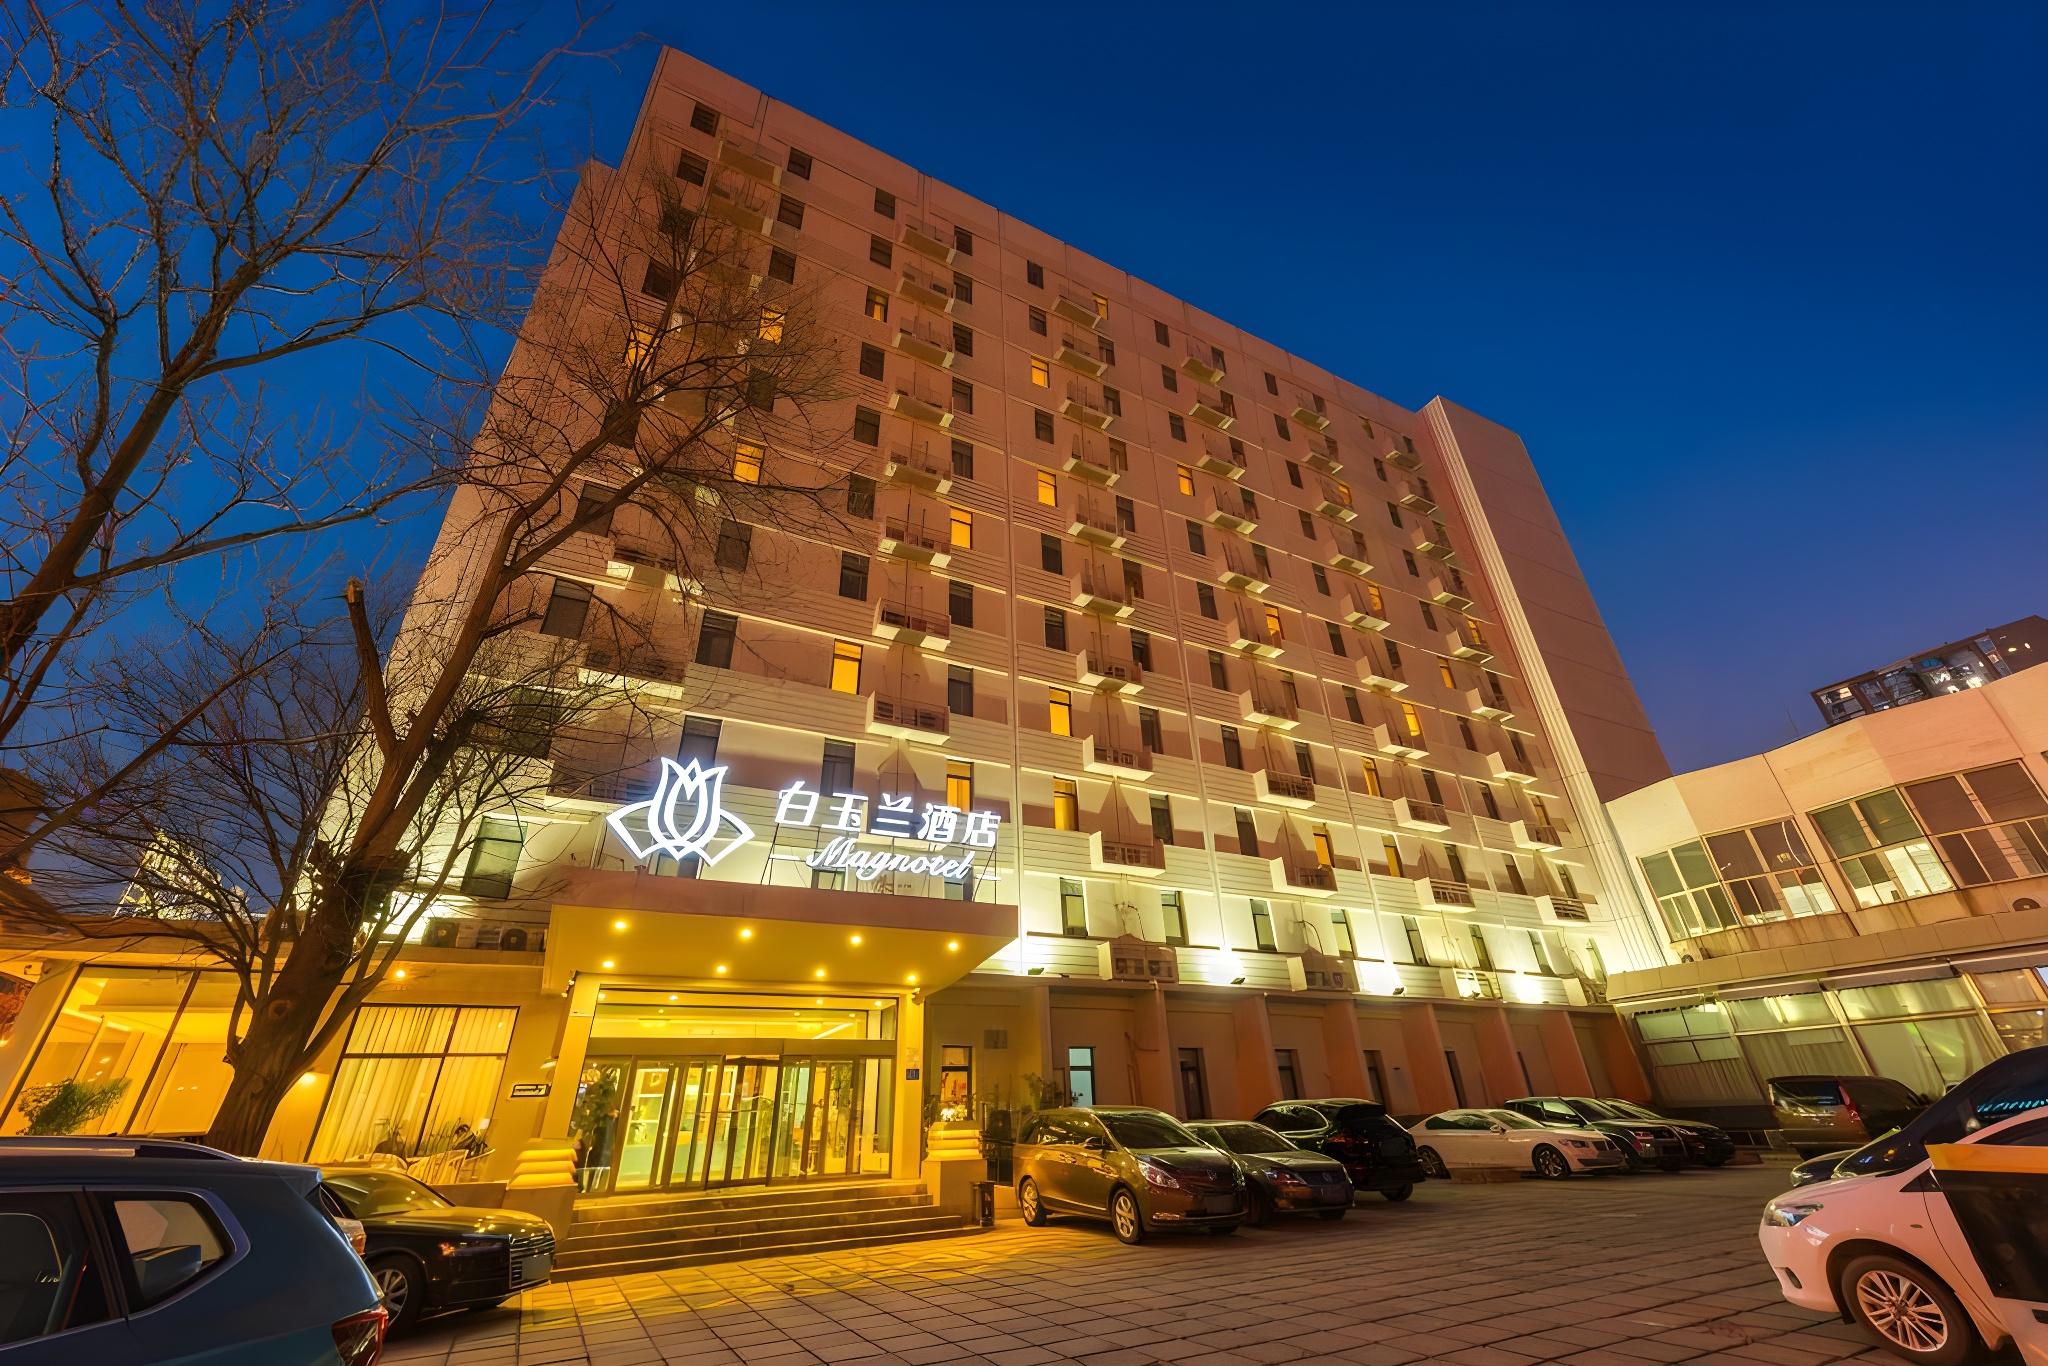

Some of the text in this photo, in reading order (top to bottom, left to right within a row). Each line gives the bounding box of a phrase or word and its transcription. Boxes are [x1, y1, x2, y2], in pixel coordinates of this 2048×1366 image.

[775, 781, 1001, 848] 白玉兰酒店
[806, 836, 976, 881] Magnotel
